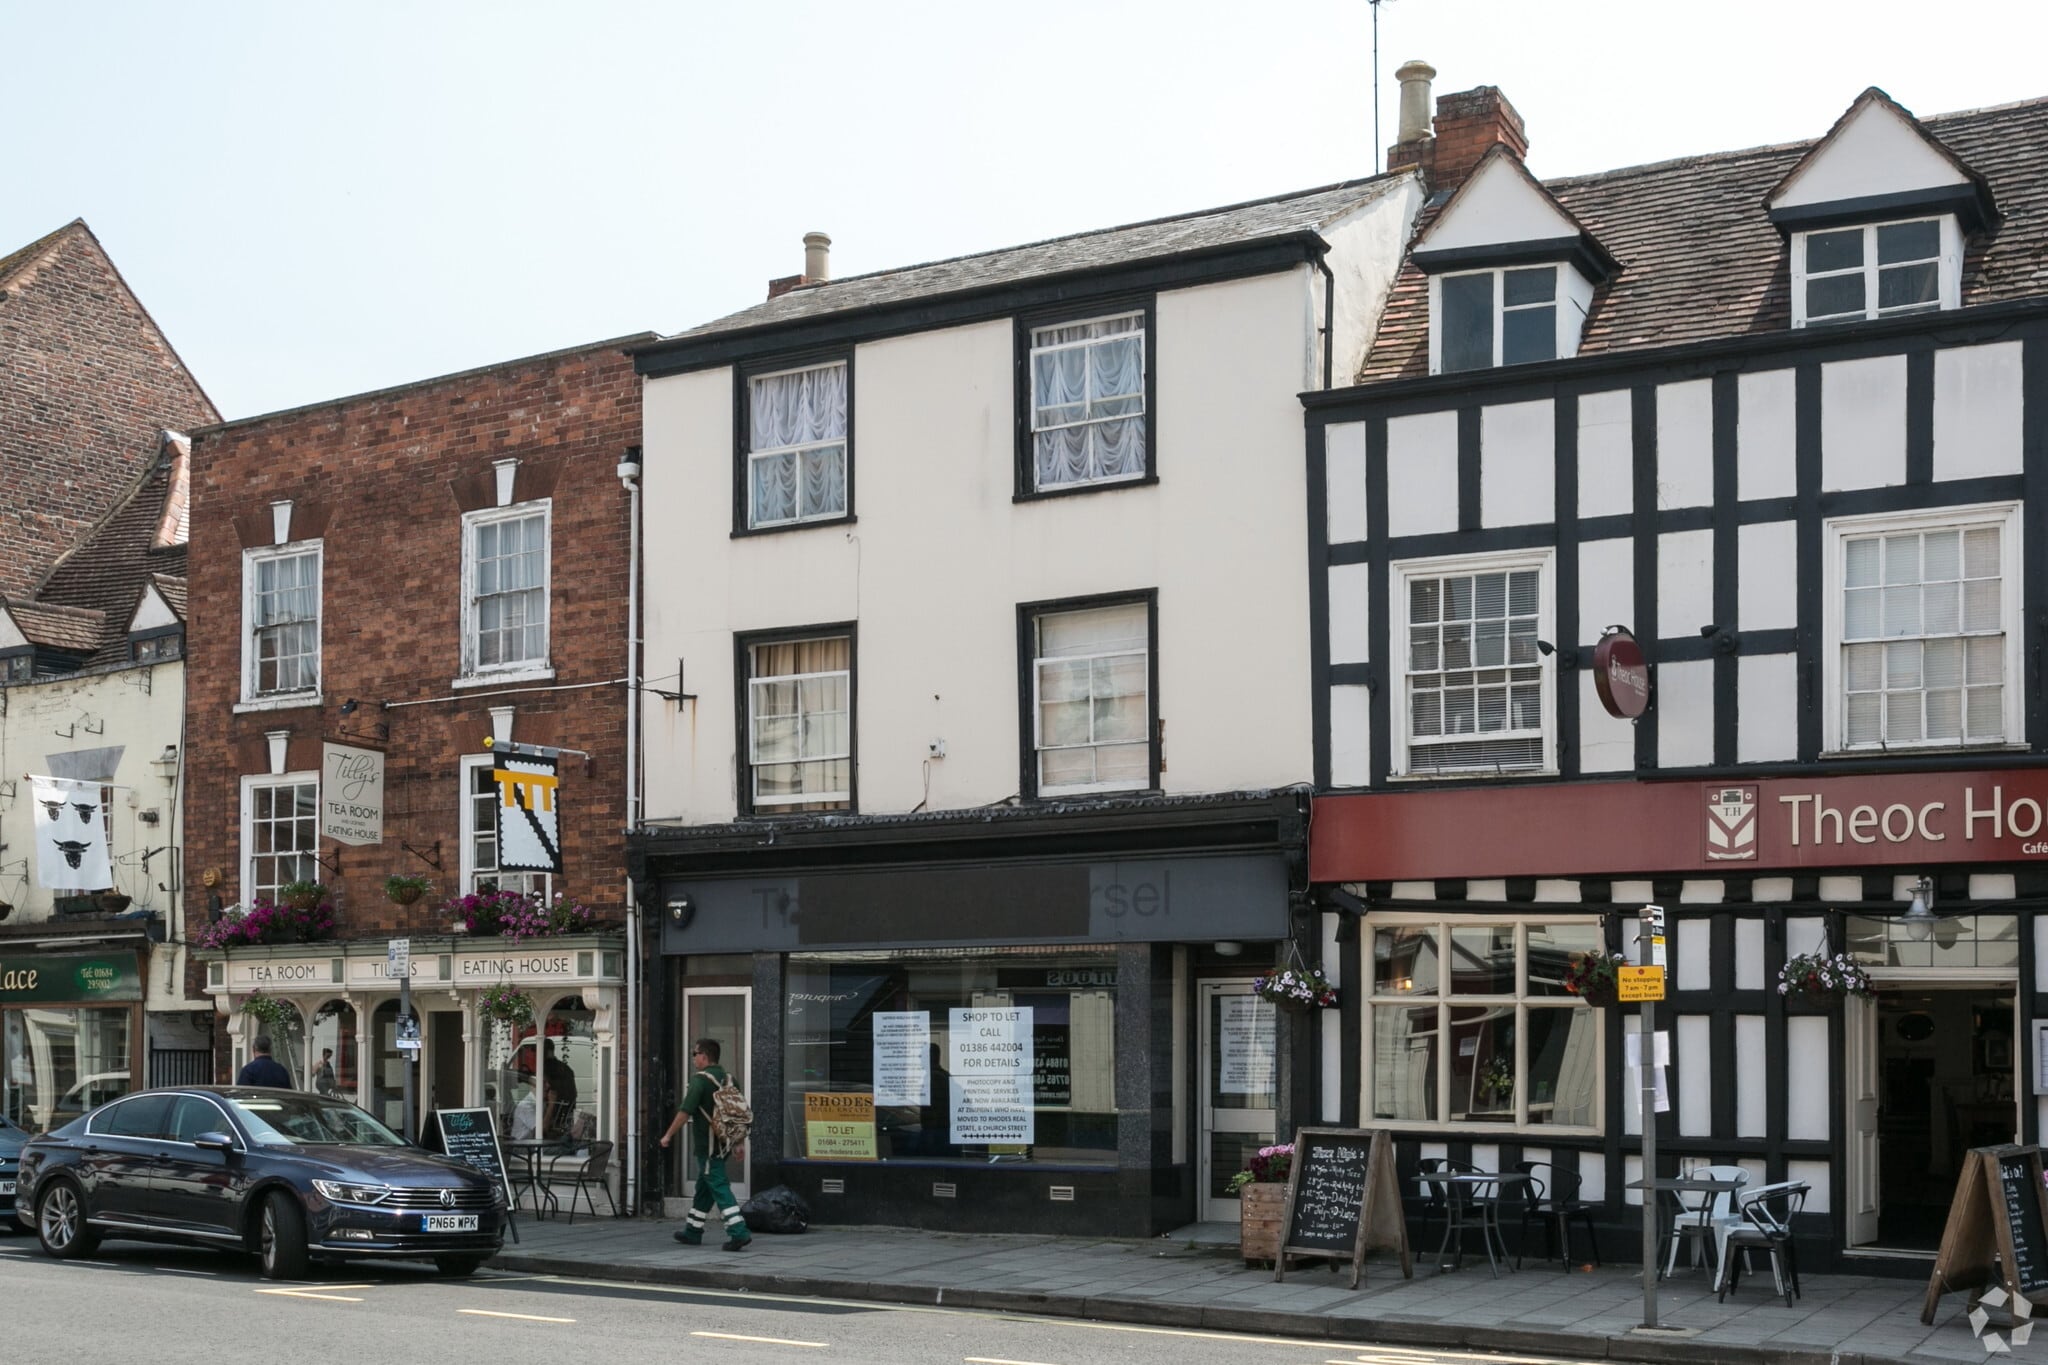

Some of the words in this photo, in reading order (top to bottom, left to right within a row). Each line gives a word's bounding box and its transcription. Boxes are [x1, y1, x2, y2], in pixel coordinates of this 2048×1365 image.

[328, 752, 380, 801] Tilly's
[328, 802, 347, 816] TEA
[350, 806, 378, 820] ROOM
[1779, 793, 1945, 846] Theoc
[1965, 786, 2048, 840] Ho
[328, 824, 352, 837] EATING
[354, 829, 378, 840] HOUSE
[464, 960, 514, 974] EATING
[520, 958, 568, 973] HOUSE
[94, 968, 113, 978] 01684
[248, 966, 272, 980] TEA
[278, 965, 316, 980] ROOM
[1633, 976, 1660, 984] stopping
[962, 1012, 988, 1022] SHOP
[990, 1012, 1003, 1022] TO
[1006, 1012, 1020, 1022] LET
[980, 1028, 1001, 1037] CALL
[960, 1043, 988, 1052] 01386
[990, 1042, 1023, 1052] 442004
[963, 1058, 982, 1068] FOR
[984, 1058, 1020, 1068] DETAILS
[808, 1096, 873, 1107] RHODES
[827, 1126, 838, 1134] TO
[840, 1126, 855, 1134] LET
[429, 1217, 456, 1229] PN66
[458, 1216, 476, 1228] WPK
